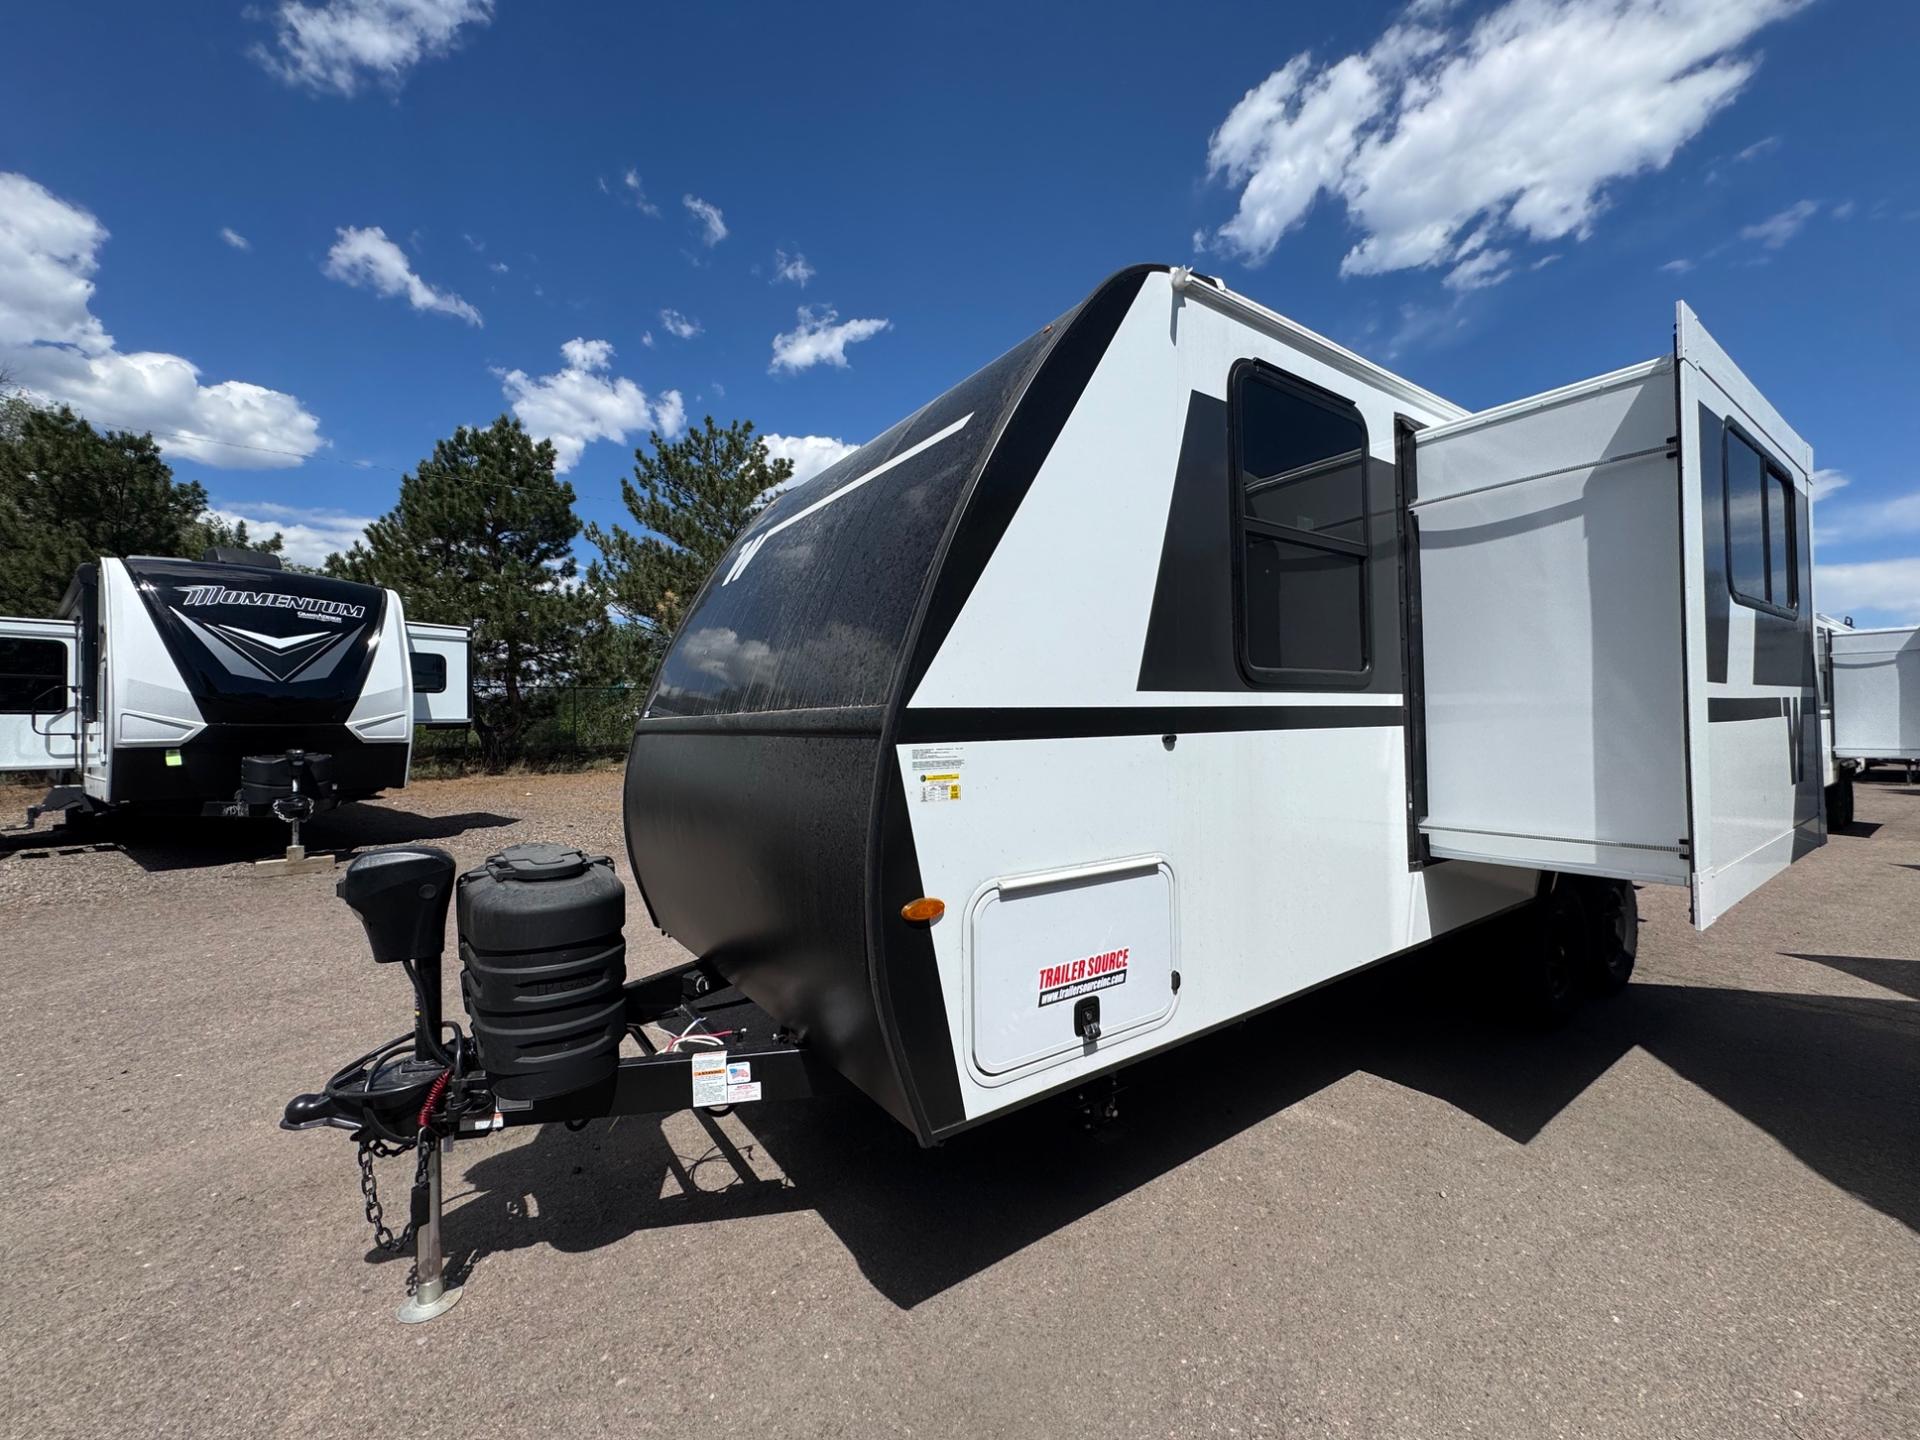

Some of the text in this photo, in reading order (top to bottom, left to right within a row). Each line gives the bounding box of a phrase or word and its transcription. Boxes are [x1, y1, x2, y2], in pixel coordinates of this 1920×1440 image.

[173, 585, 365, 618] MOMENTUM
[1040, 948, 1129, 990] TRAILER SOURCE
[1041, 973, 1125, 1005] www.trailersourceinc.com
